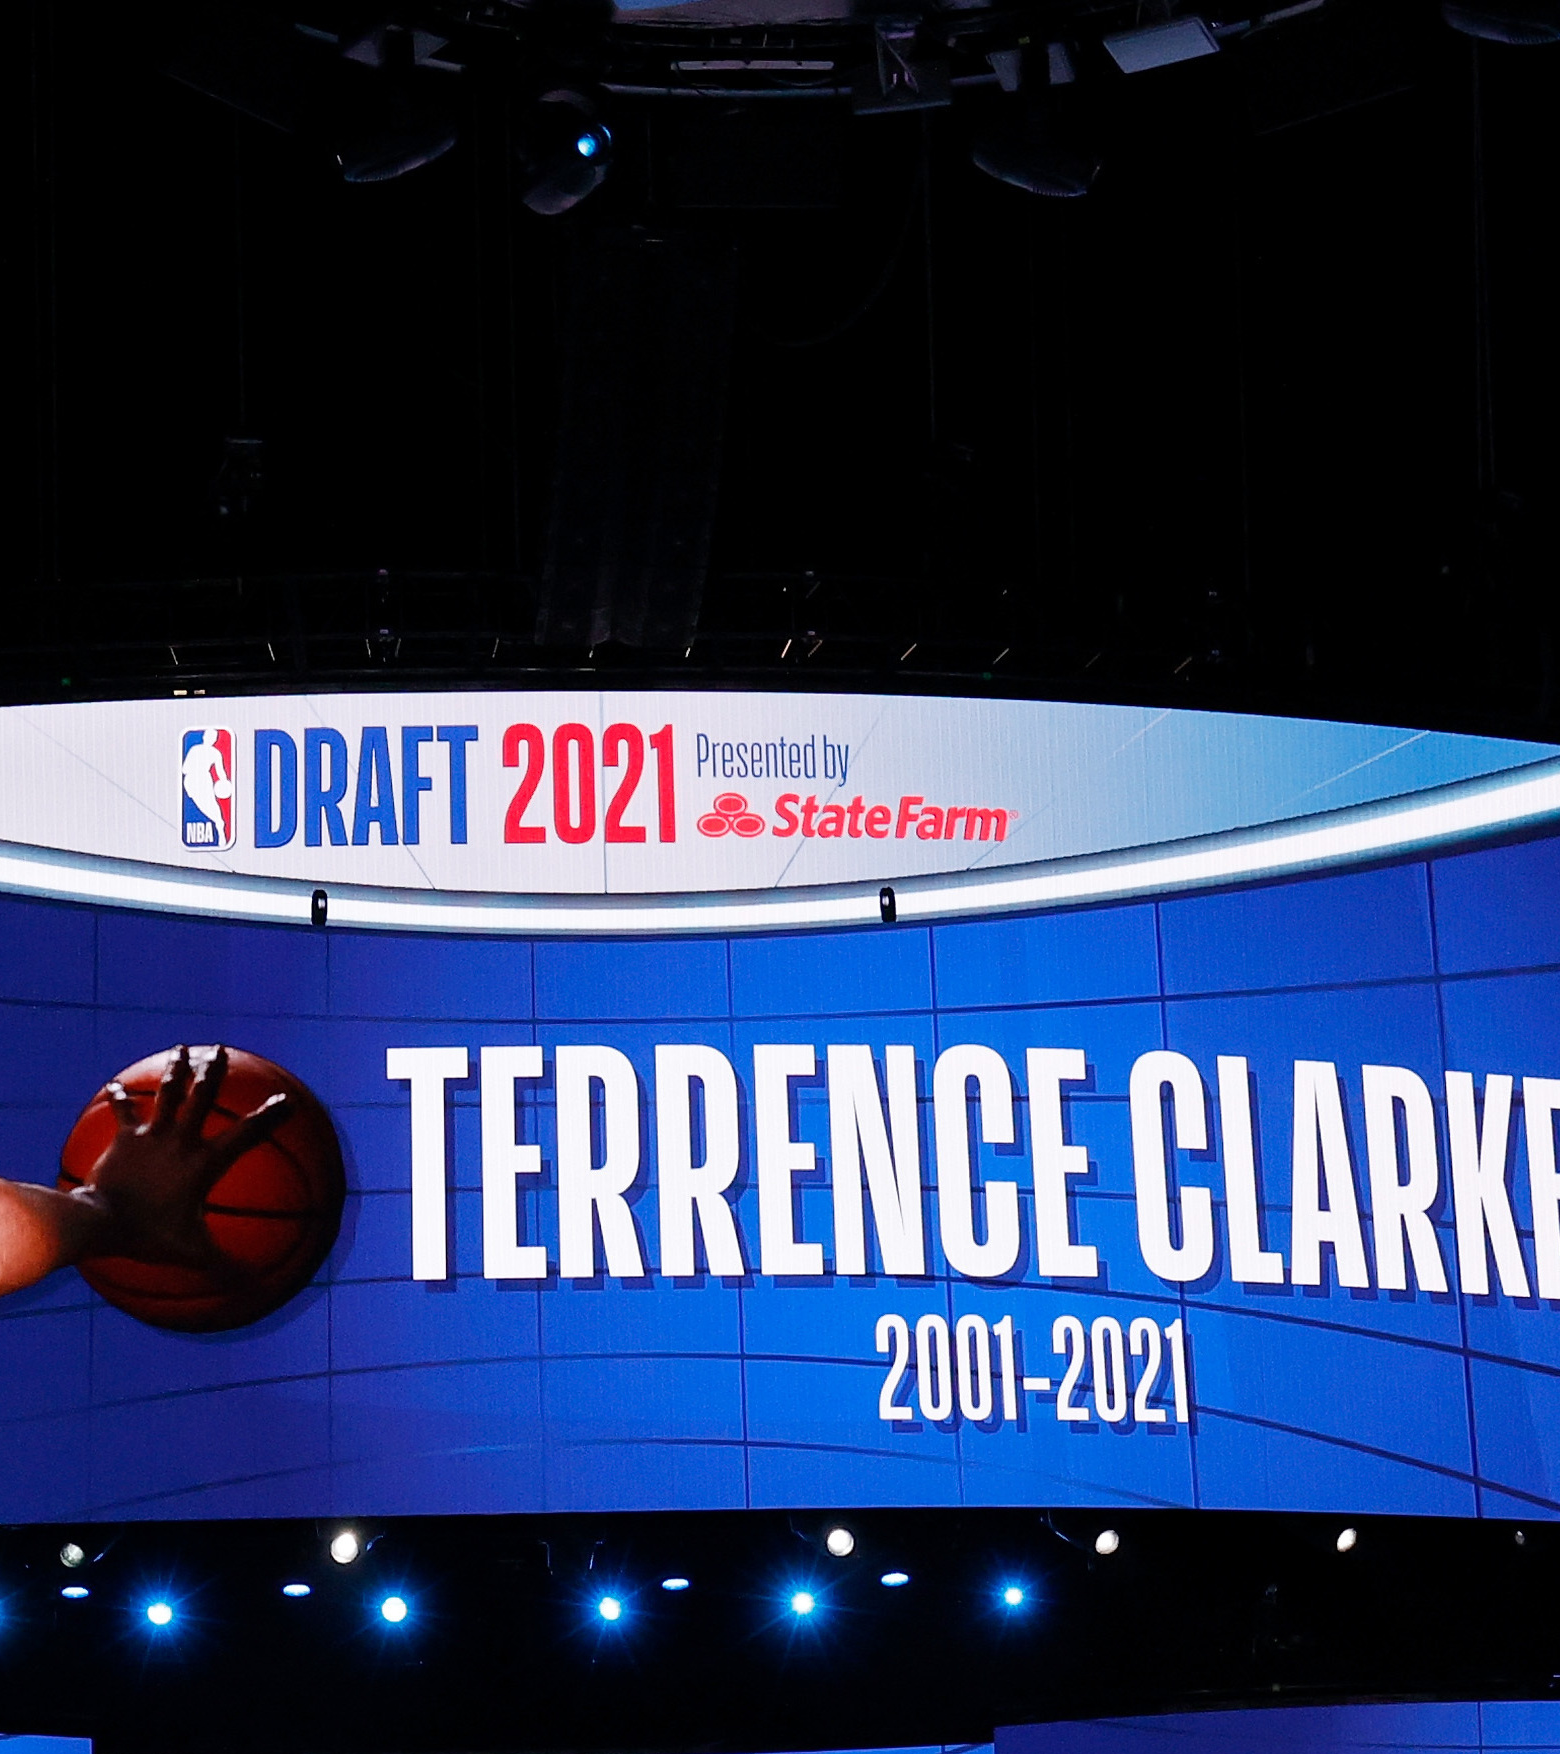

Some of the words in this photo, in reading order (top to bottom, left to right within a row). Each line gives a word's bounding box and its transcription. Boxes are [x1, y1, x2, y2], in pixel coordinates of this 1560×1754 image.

[255, 725, 478, 848] DRAFT
[503, 723, 675, 844] 2021
[696, 733, 817, 779] Presented
[823, 734, 849, 787] by
[186, 822, 214, 844] NBA
[387, 1045, 1098, 1280] TERRENCE
